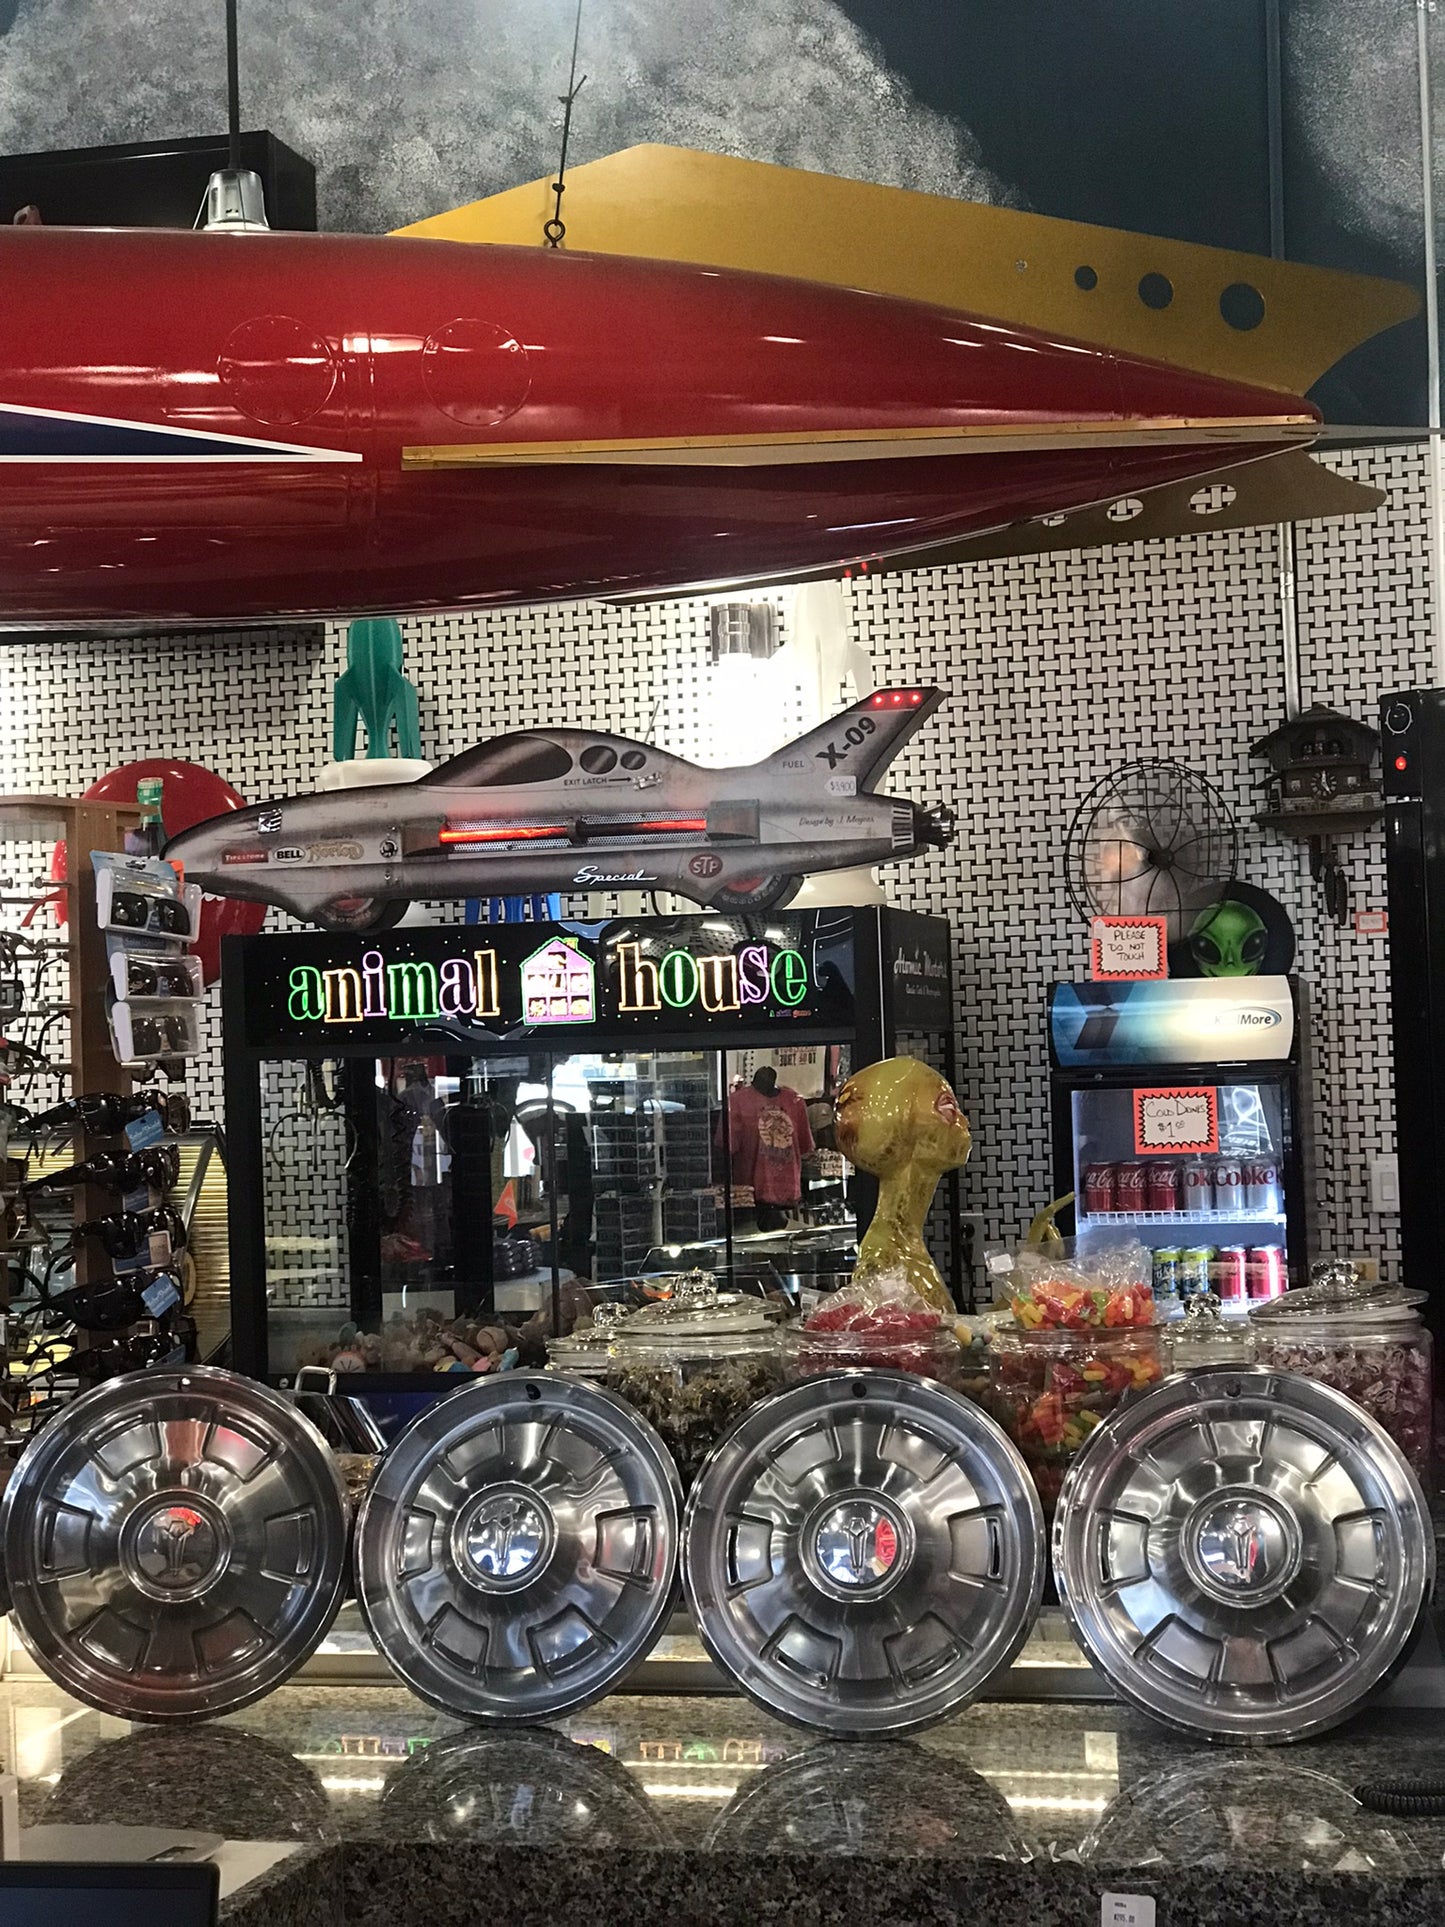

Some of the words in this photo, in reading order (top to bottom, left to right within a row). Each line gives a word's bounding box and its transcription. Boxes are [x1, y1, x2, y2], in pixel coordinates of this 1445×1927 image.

[815, 717, 876, 770] X-09
[782, 761, 805, 769] FUEL
[563, 778, 581, 786] EXIT
[583, 777, 607, 786] LATCH
[277, 849, 302, 859] BELL
[692, 856, 718, 874] STP
[573, 865, 658, 885] Special
[1114, 930, 1146, 941] PLEASE
[1129, 942, 1145, 951] NOT
[1116, 952, 1145, 961] TOUCH
[288, 949, 500, 1023] animal
[617, 942, 807, 1012] house
